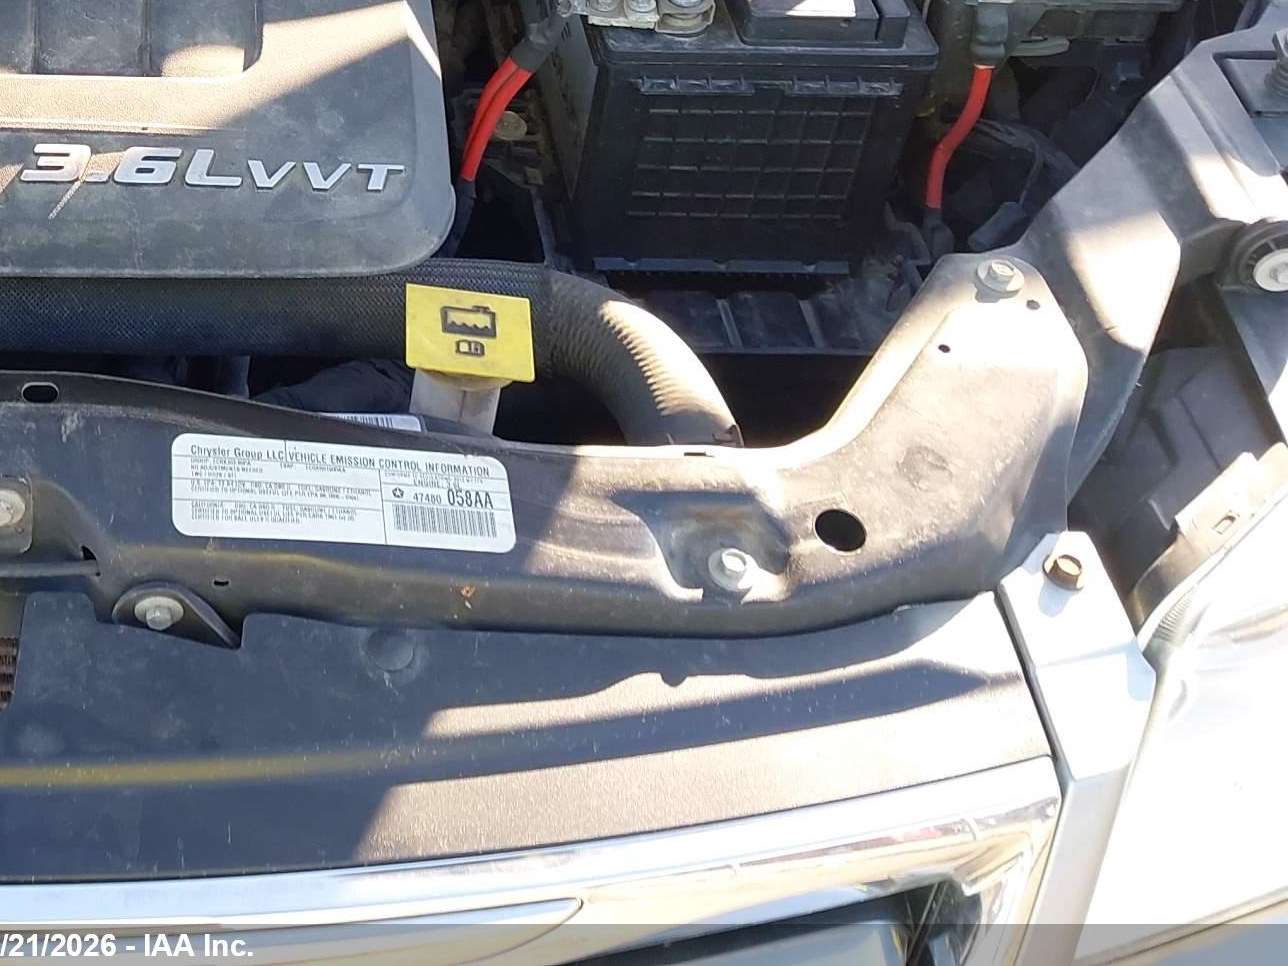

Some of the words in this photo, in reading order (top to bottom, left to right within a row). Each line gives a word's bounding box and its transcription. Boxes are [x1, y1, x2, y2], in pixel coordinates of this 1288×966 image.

[20, 143, 242, 187] 3.6L
[247, 159, 405, 191] VVT
[190, 444, 230, 458] Chrysler
[234, 447, 262, 461] Group
[266, 449, 284, 460] LLC
[289, 451, 327, 465] VEHICLE
[330, 454, 375, 467] EMISSION
[378, 458, 421, 471] CONTROL
[425, 462, 490, 477] INFORMATION
[447, 489, 494, 508] 058AA
